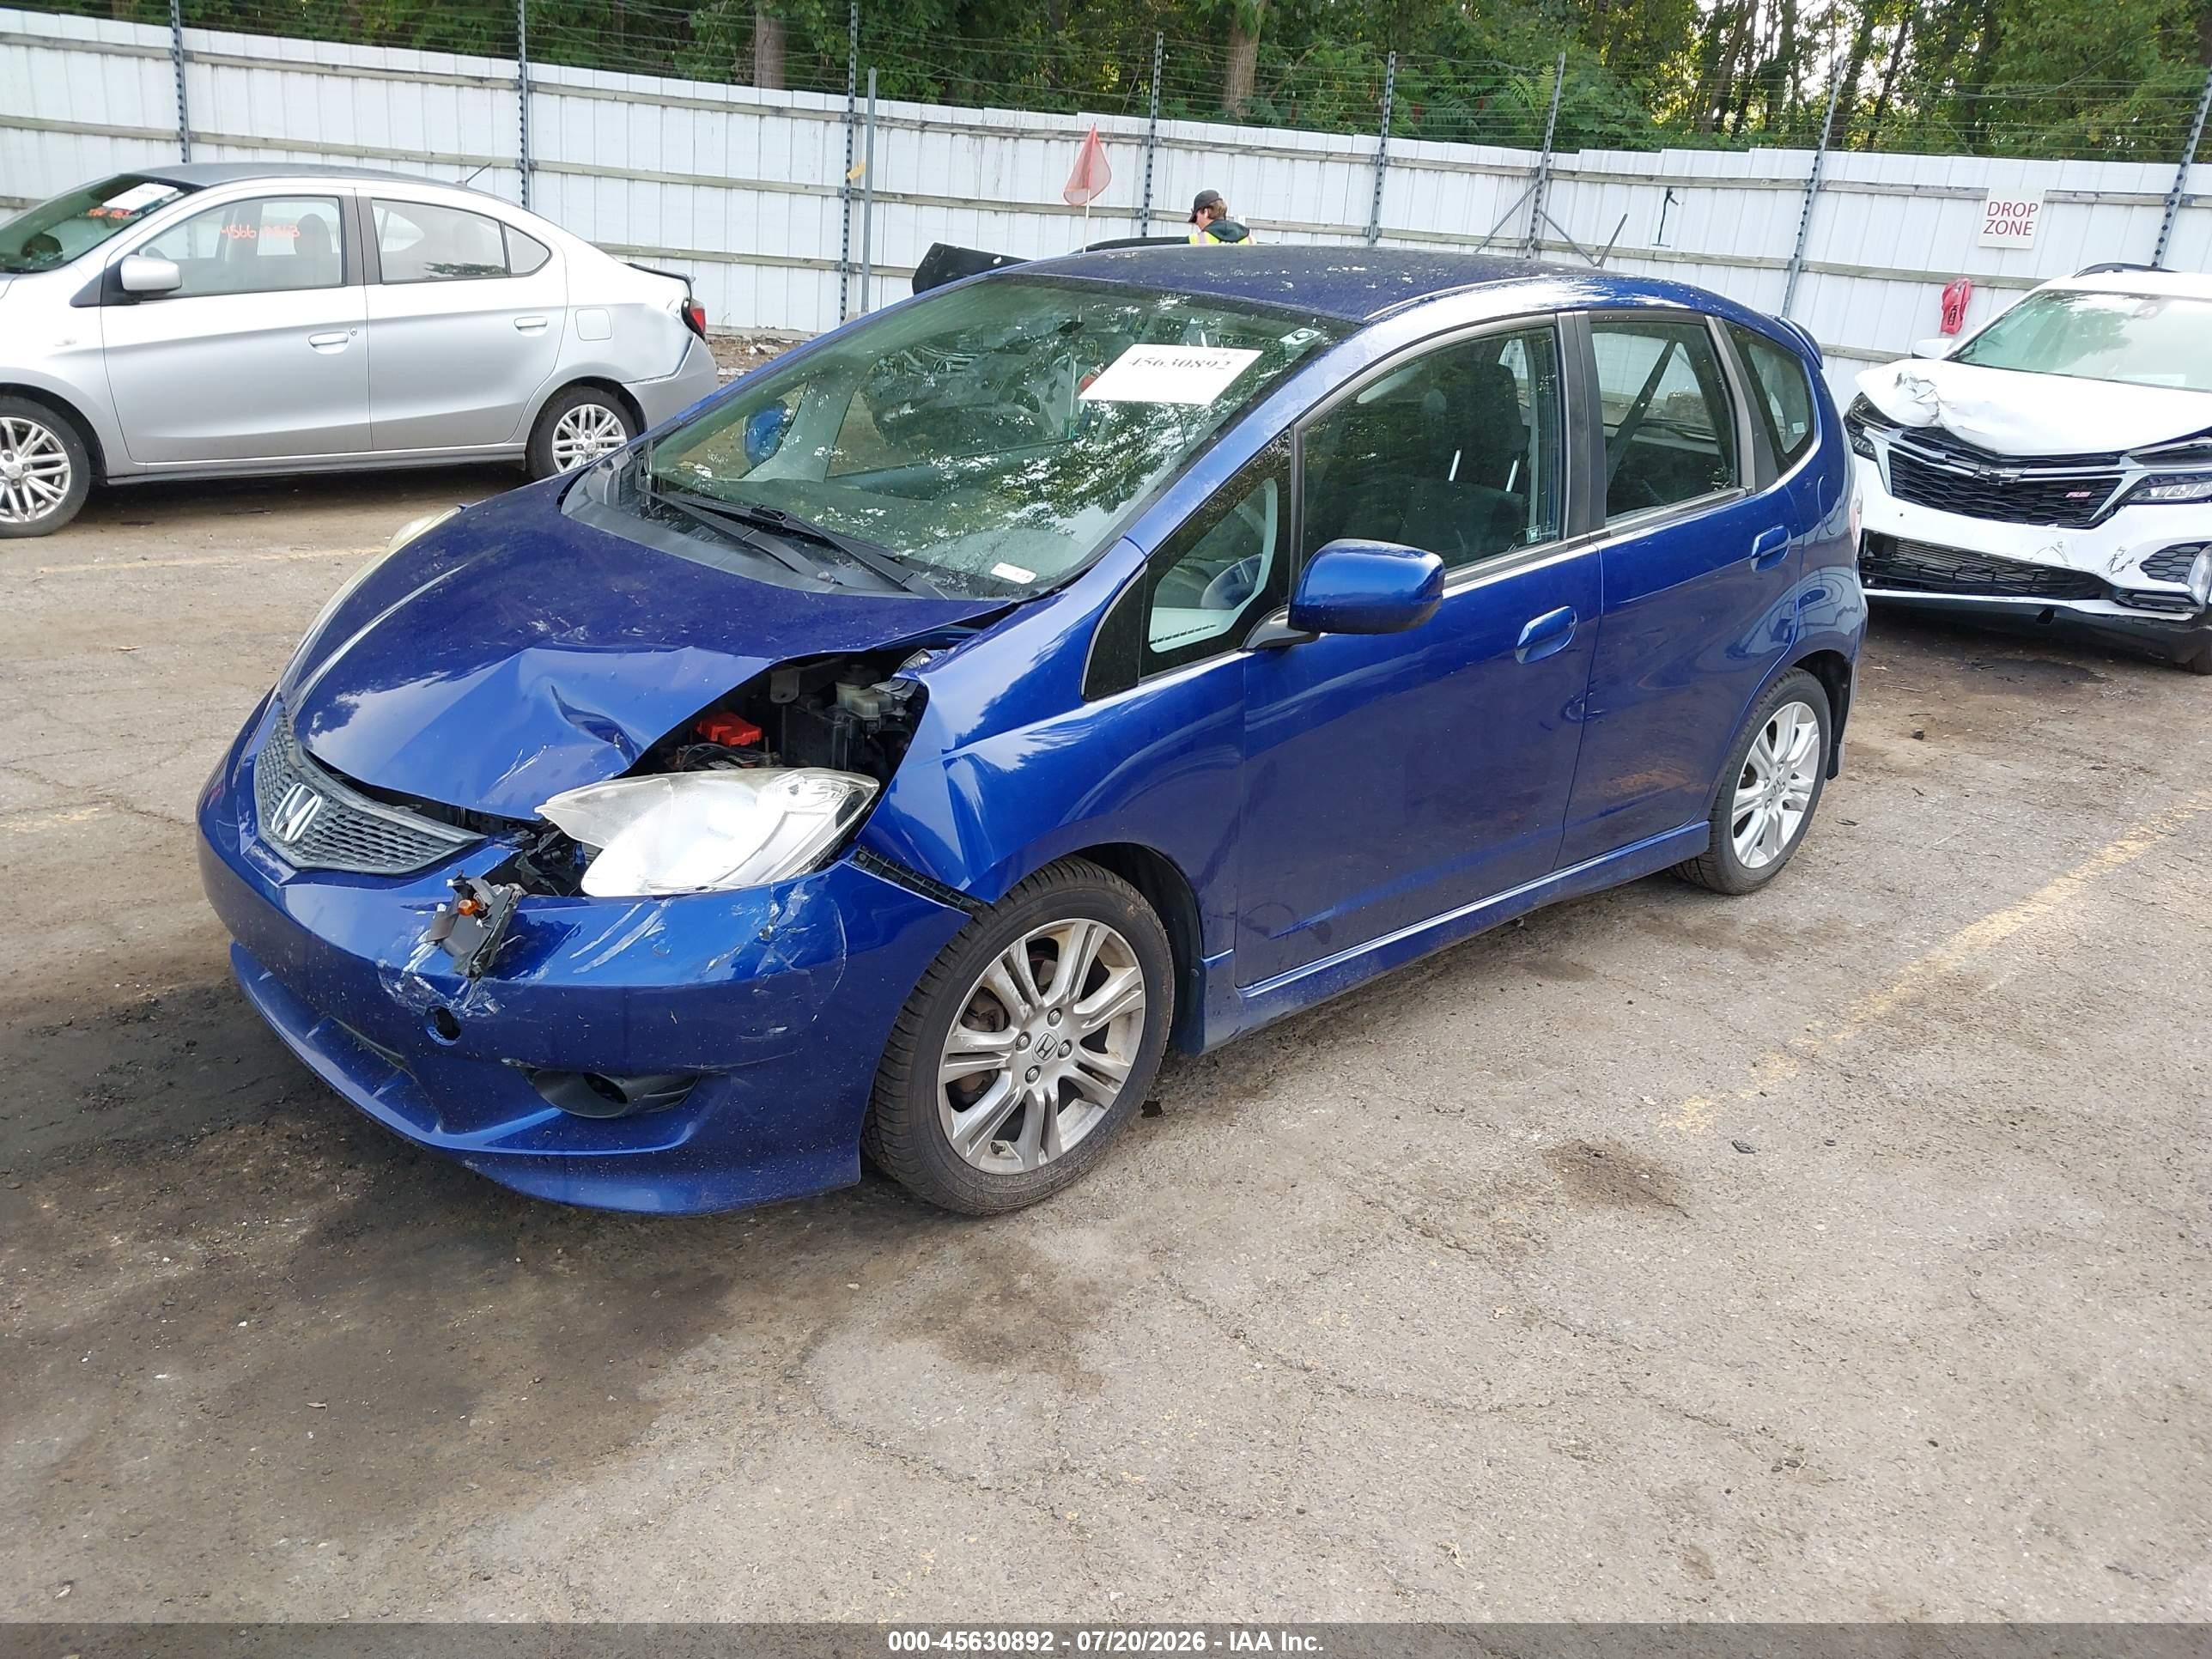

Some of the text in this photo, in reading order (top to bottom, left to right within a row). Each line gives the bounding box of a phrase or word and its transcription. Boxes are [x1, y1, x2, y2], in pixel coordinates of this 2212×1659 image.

[1987, 201, 2039, 218] DROP
[1983, 219, 2034, 236] ZONE
[1128, 357, 1231, 370] 45630892
